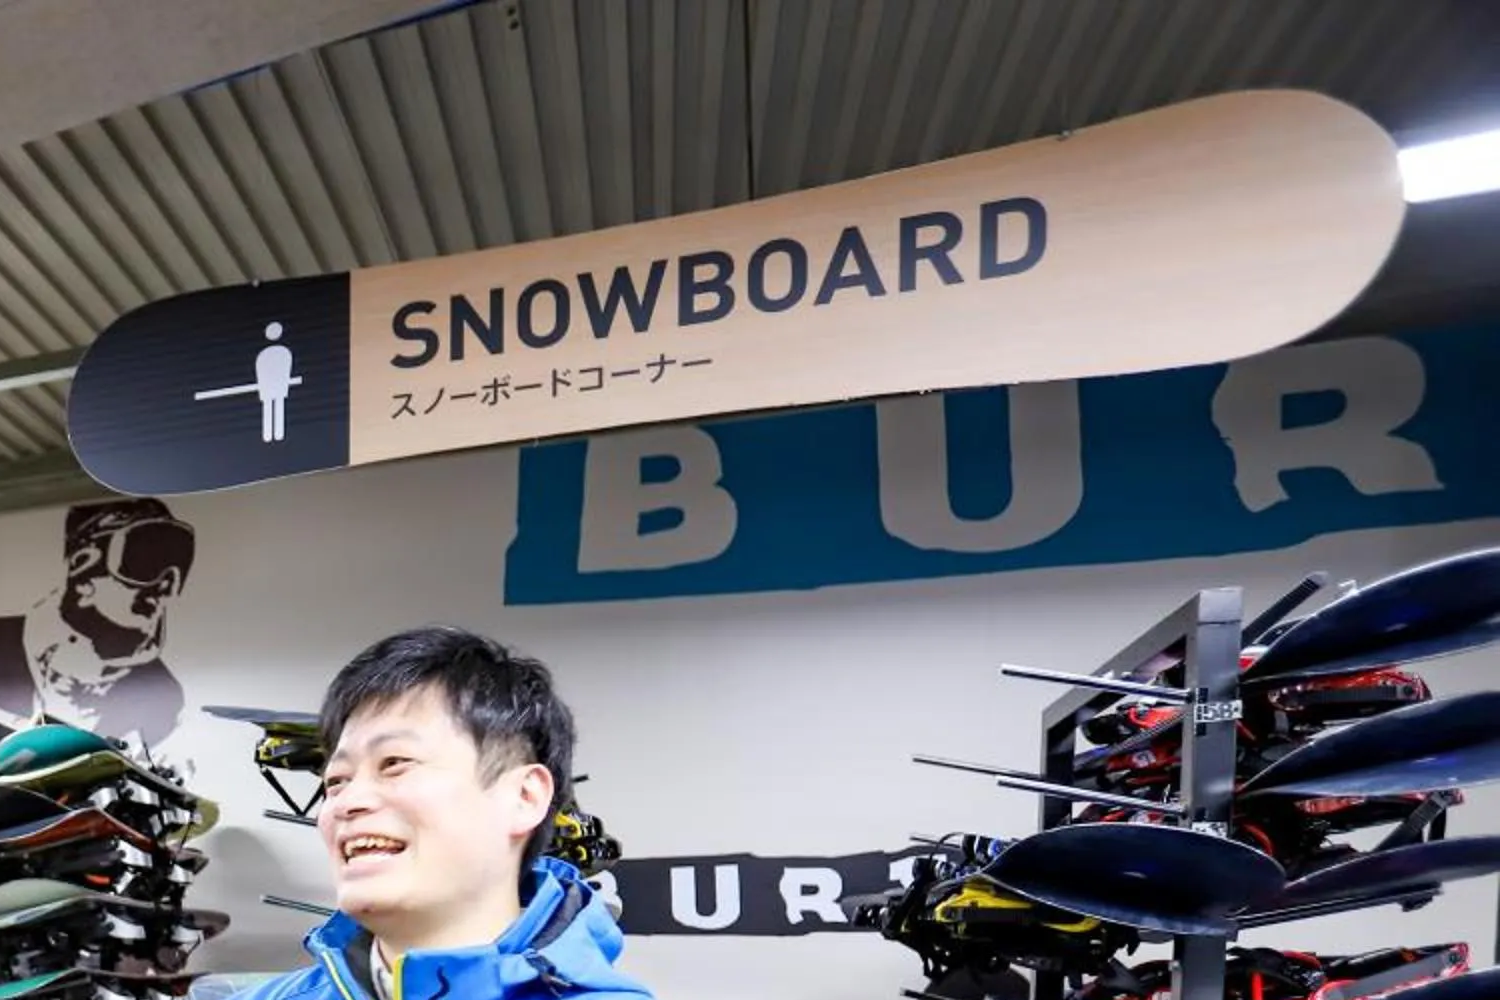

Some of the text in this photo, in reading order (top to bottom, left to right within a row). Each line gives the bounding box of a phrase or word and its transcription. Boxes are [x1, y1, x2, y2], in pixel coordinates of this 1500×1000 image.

[390, 196, 1048, 368] SNOWBOARD
[390, 353, 713, 419] スノーボードコーナー
